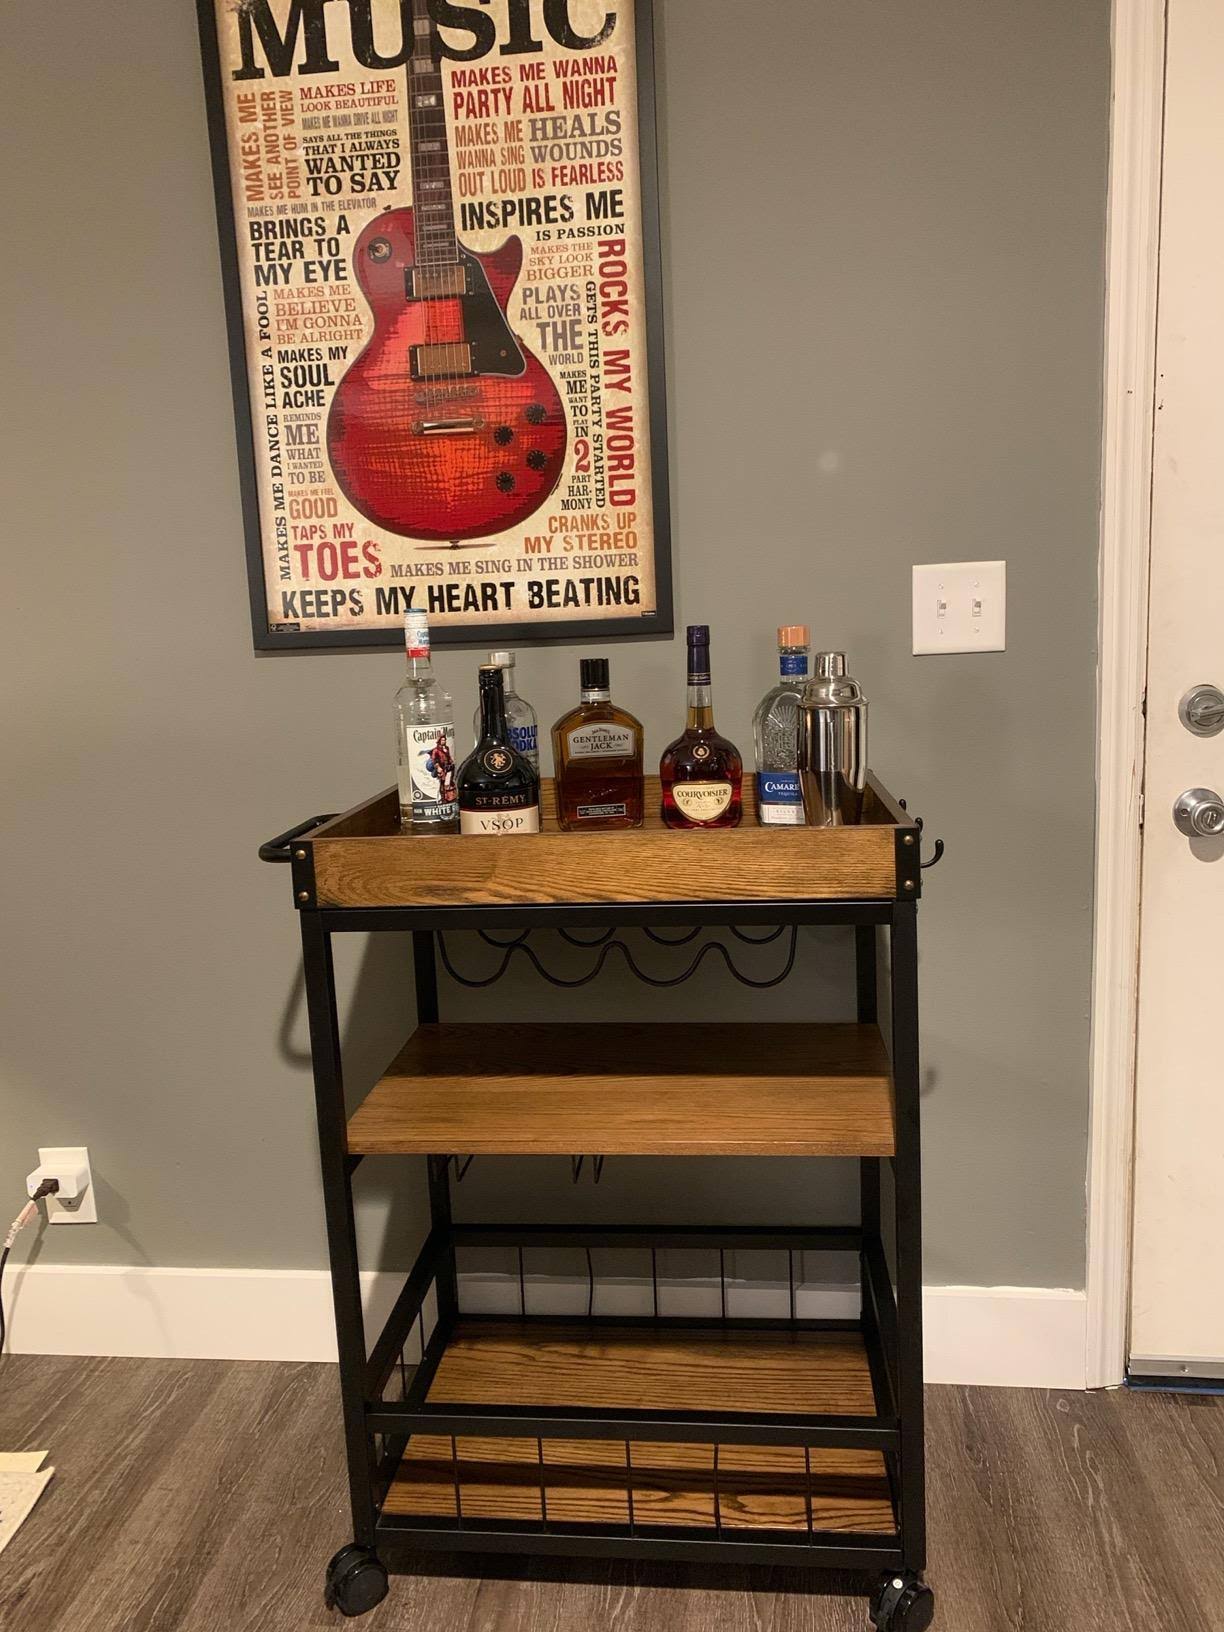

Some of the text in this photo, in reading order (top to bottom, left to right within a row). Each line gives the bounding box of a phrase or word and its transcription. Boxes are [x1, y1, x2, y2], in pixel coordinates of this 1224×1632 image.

[232, 0, 617, 81] MUSIC
[451, 56, 618, 88] MAKES ME WANNA
[300, 79, 396, 100] MAKES LIFE
[453, 77, 616, 120] PARTY ALL NIGHT
[301, 95, 398, 112] LOOK BEAUTIFUL
[302, 128, 397, 144] SAYS ALL THE THINGS
[455, 120, 523, 148] MAKES ME
[528, 110, 622, 142] HEALS
[238, 92, 264, 201] MAKES ME
[261, 91, 284, 200] SEE ANOTHER
[279, 90, 300, 199] POINT OF VIEW
[302, 138, 400, 156] THAT I ALWAYS
[530, 138, 622, 164] WOUNDS
[304, 152, 400, 175] WANTED
[456, 146, 524, 170] WANNA SING
[306, 170, 400, 196] TO SAY
[458, 168, 526, 197] OUT LOUD
[532, 160, 624, 189] IS FEARLESS
[248, 198, 376, 218] MAKES ME HUM IN THE ELEVATOR
[460, 189, 624, 232] INSPIRES ME
[249, 214, 350, 241] BRINGS A
[536, 224, 624, 241] IS PASSION
[252, 237, 340, 262] TEAR TO
[530, 242, 593, 256] MAKES THE
[530, 252, 594, 266] SKY LOOK
[254, 258, 348, 287] MY EYE
[526, 264, 594, 281] BIGGER
[273, 284, 350, 300] MAKES ME
[522, 284, 581, 304] PLAYS
[274, 298, 356, 316] BELIEVE
[520, 304, 582, 320] ALL OVER
[276, 314, 362, 330] I'M GONNA
[278, 329, 364, 344] BE ALRIGHT
[536, 319, 584, 352] THE
[278, 346, 348, 364] MAKES MY
[548, 352, 584, 366] WORLD
[280, 363, 335, 389] SOUL
[560, 370, 586, 380] MAKES
[598, 238, 636, 507] ROCKS MY WORLD
[566, 380, 587, 394] ME
[586, 281, 606, 508] GETS THIS PARTY STARTED
[282, 390, 326, 409] ACHE
[284, 412, 322, 422] REMINDS
[571, 405, 588, 416] TO
[256, 290, 291, 580] MAKES ME DANCE LIKE A FOOL
[284, 424, 320, 446] ME
[574, 426, 588, 438] IN
[286, 448, 320, 460] WHAT
[574, 438, 590, 473] 2
[292, 461, 324, 470] WANTED
[288, 471, 326, 484] TO BE
[572, 474, 591, 484] PART
[568, 484, 592, 496] HAR-
[288, 497, 338, 520] GOOD
[561, 498, 592, 510] MONY
[291, 522, 354, 540] TAPS MY
[548, 512, 636, 534] CRANKS UP
[524, 531, 638, 554] MY STEREO
[294, 540, 382, 582] TOES
[390, 553, 639, 578] MAKES ME SING IN THE SHOWER
[282, 576, 640, 618] KEEPS MY HEART BEATING
[573, 734, 629, 744] GENTLEMAN
[590, 742, 613, 751] JACK
[677, 789, 728, 800] COURVOISIER
[424, 806, 451, 816] WHITE
[480, 818, 524, 830] VSOP
